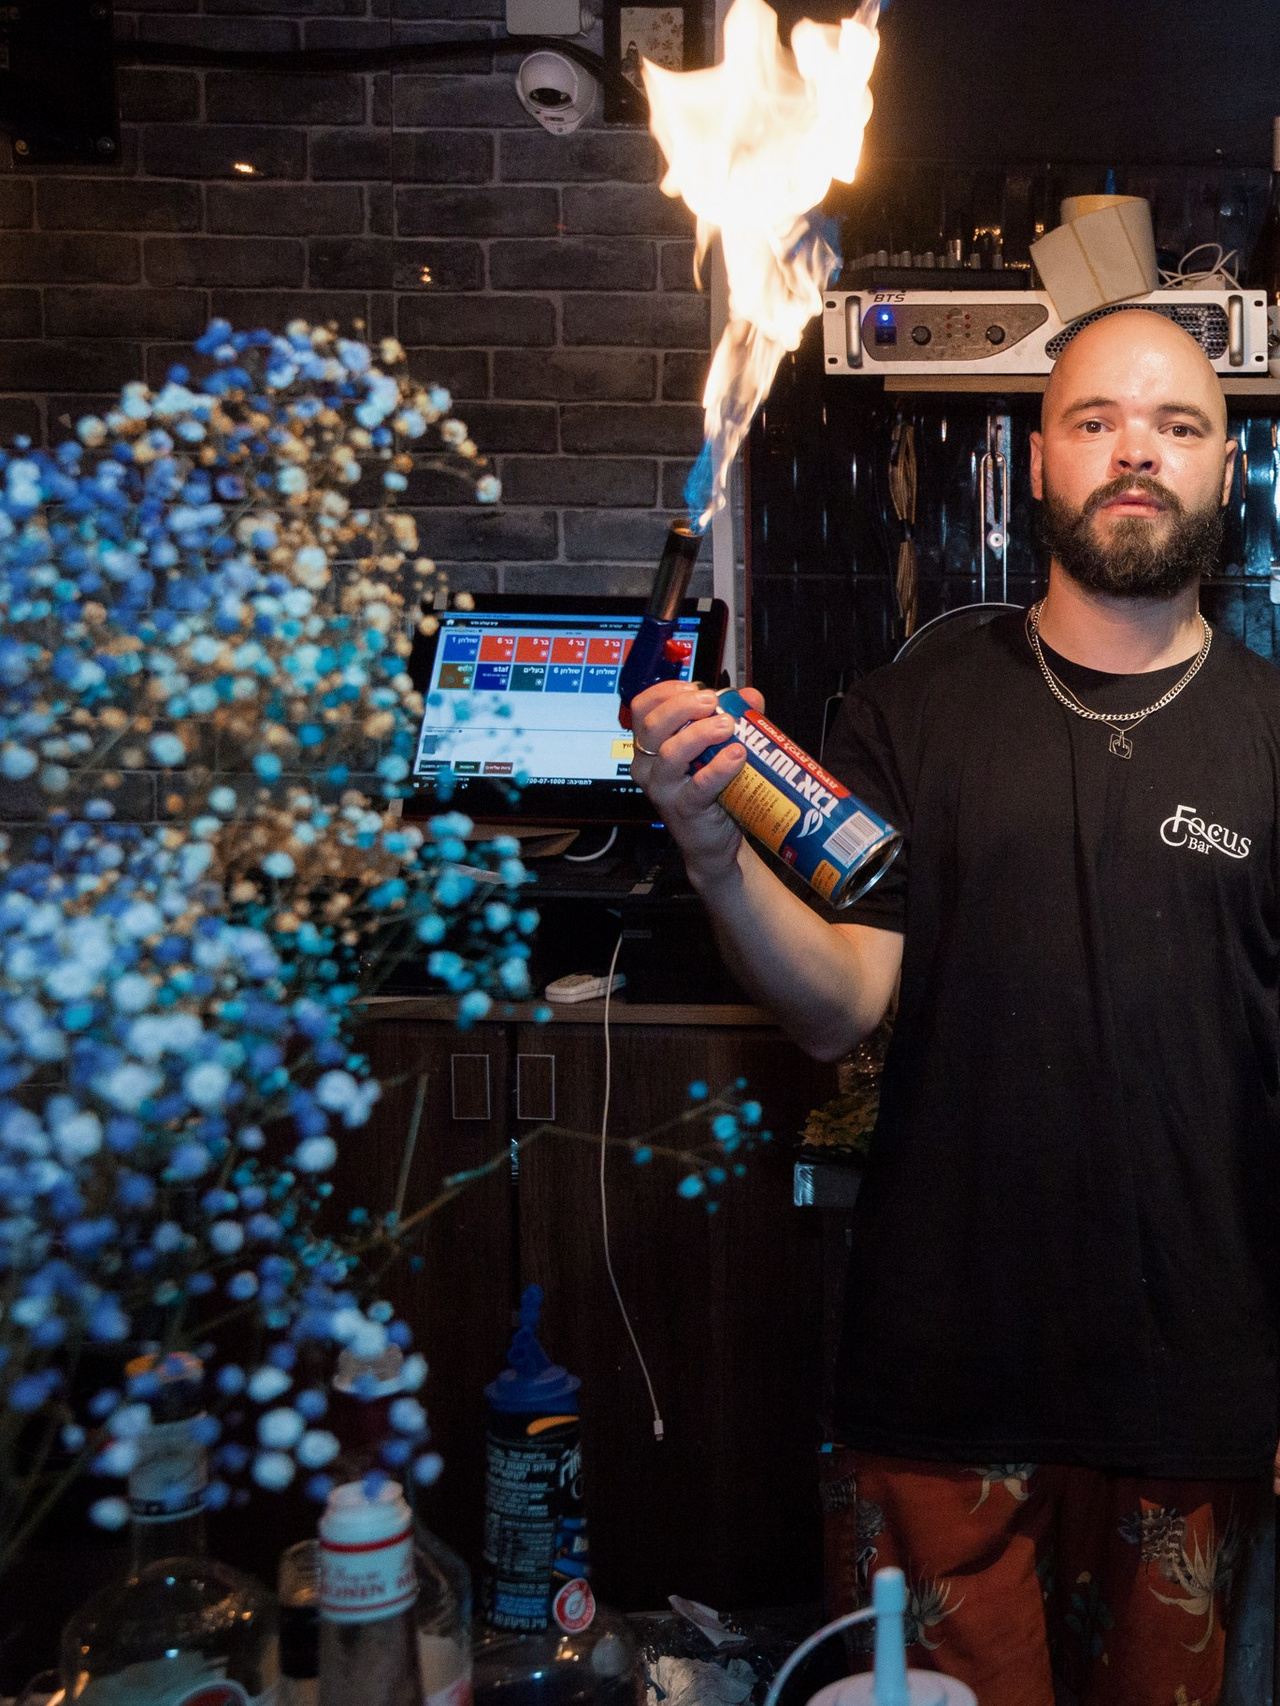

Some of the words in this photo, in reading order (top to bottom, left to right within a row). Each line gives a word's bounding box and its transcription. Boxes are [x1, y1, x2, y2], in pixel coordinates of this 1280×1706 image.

[874, 294, 906, 303] BTS
[733, 716, 840, 818] אמישראגז
[1160, 804, 1252, 859] Focus
[1187, 837, 1213, 855] Bar
